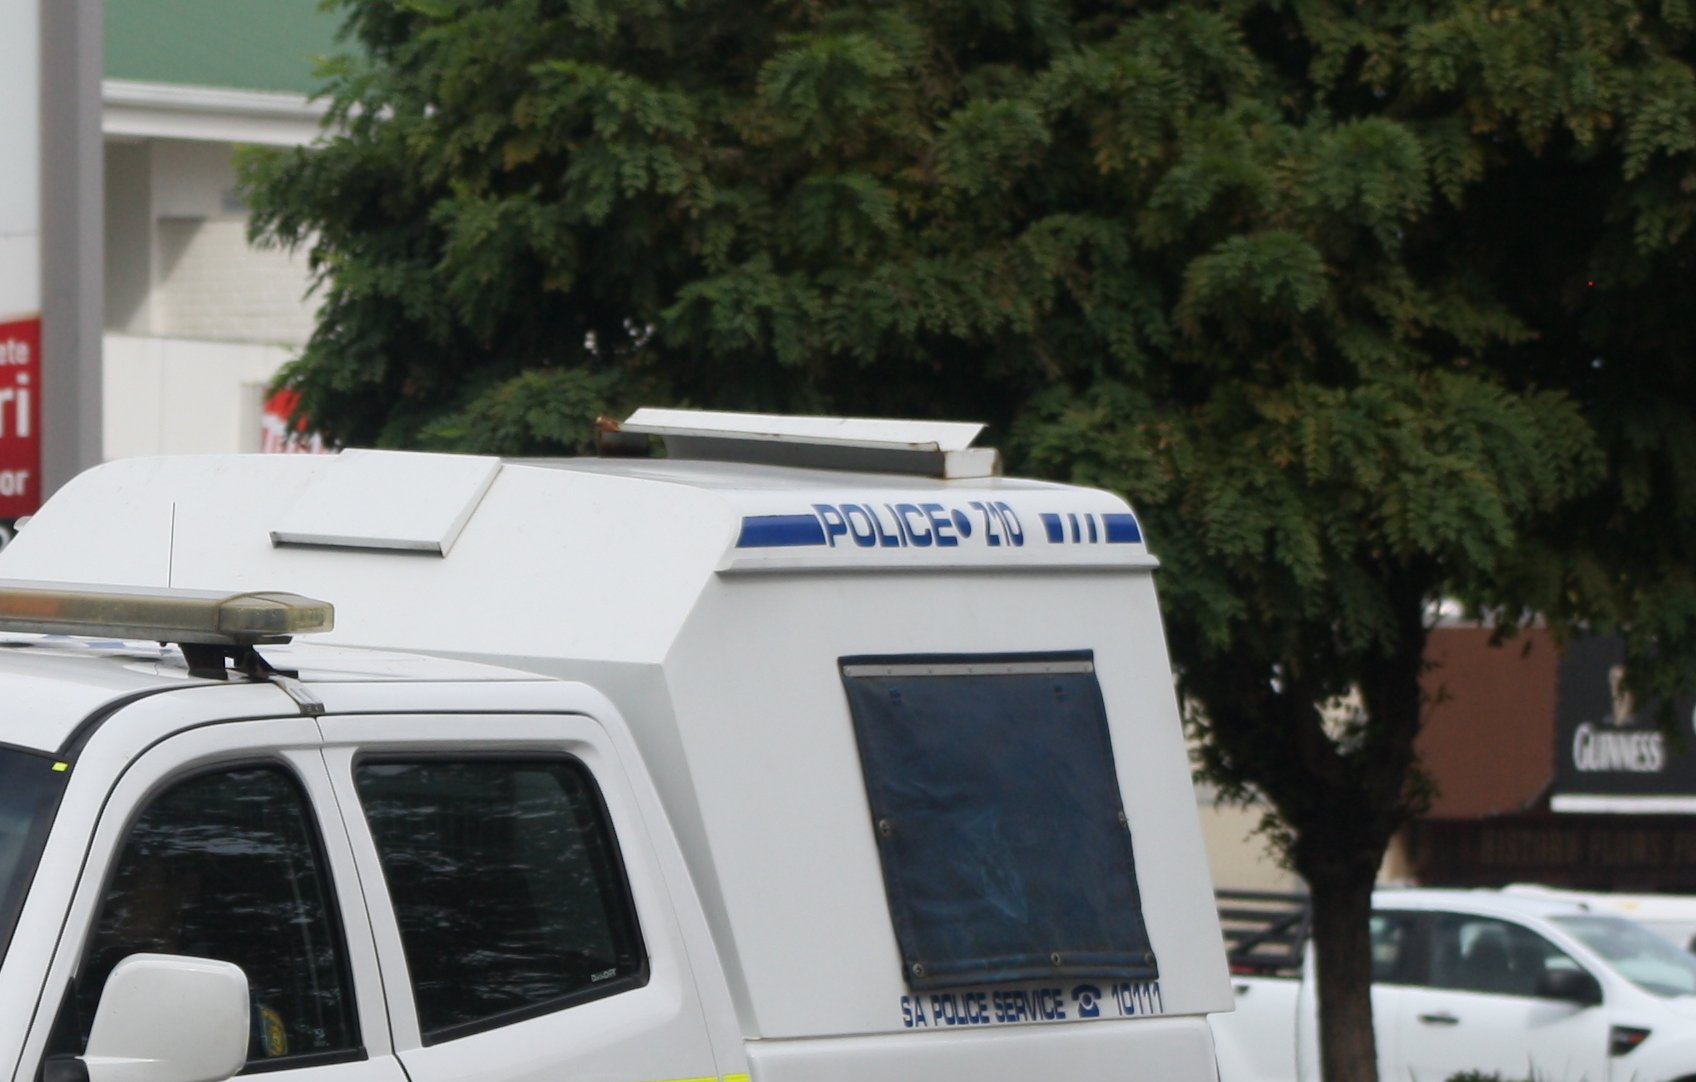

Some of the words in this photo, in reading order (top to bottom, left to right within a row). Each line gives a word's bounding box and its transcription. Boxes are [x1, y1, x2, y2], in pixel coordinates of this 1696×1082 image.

[811, 503, 959, 548] POLICE
[1572, 723, 1664, 772] GUINNESS
[901, 996, 928, 1028] SA
[932, 992, 990, 1026] POLICE
[992, 987, 1066, 1023] SERVICE
[1111, 982, 1164, 1016] 10111
